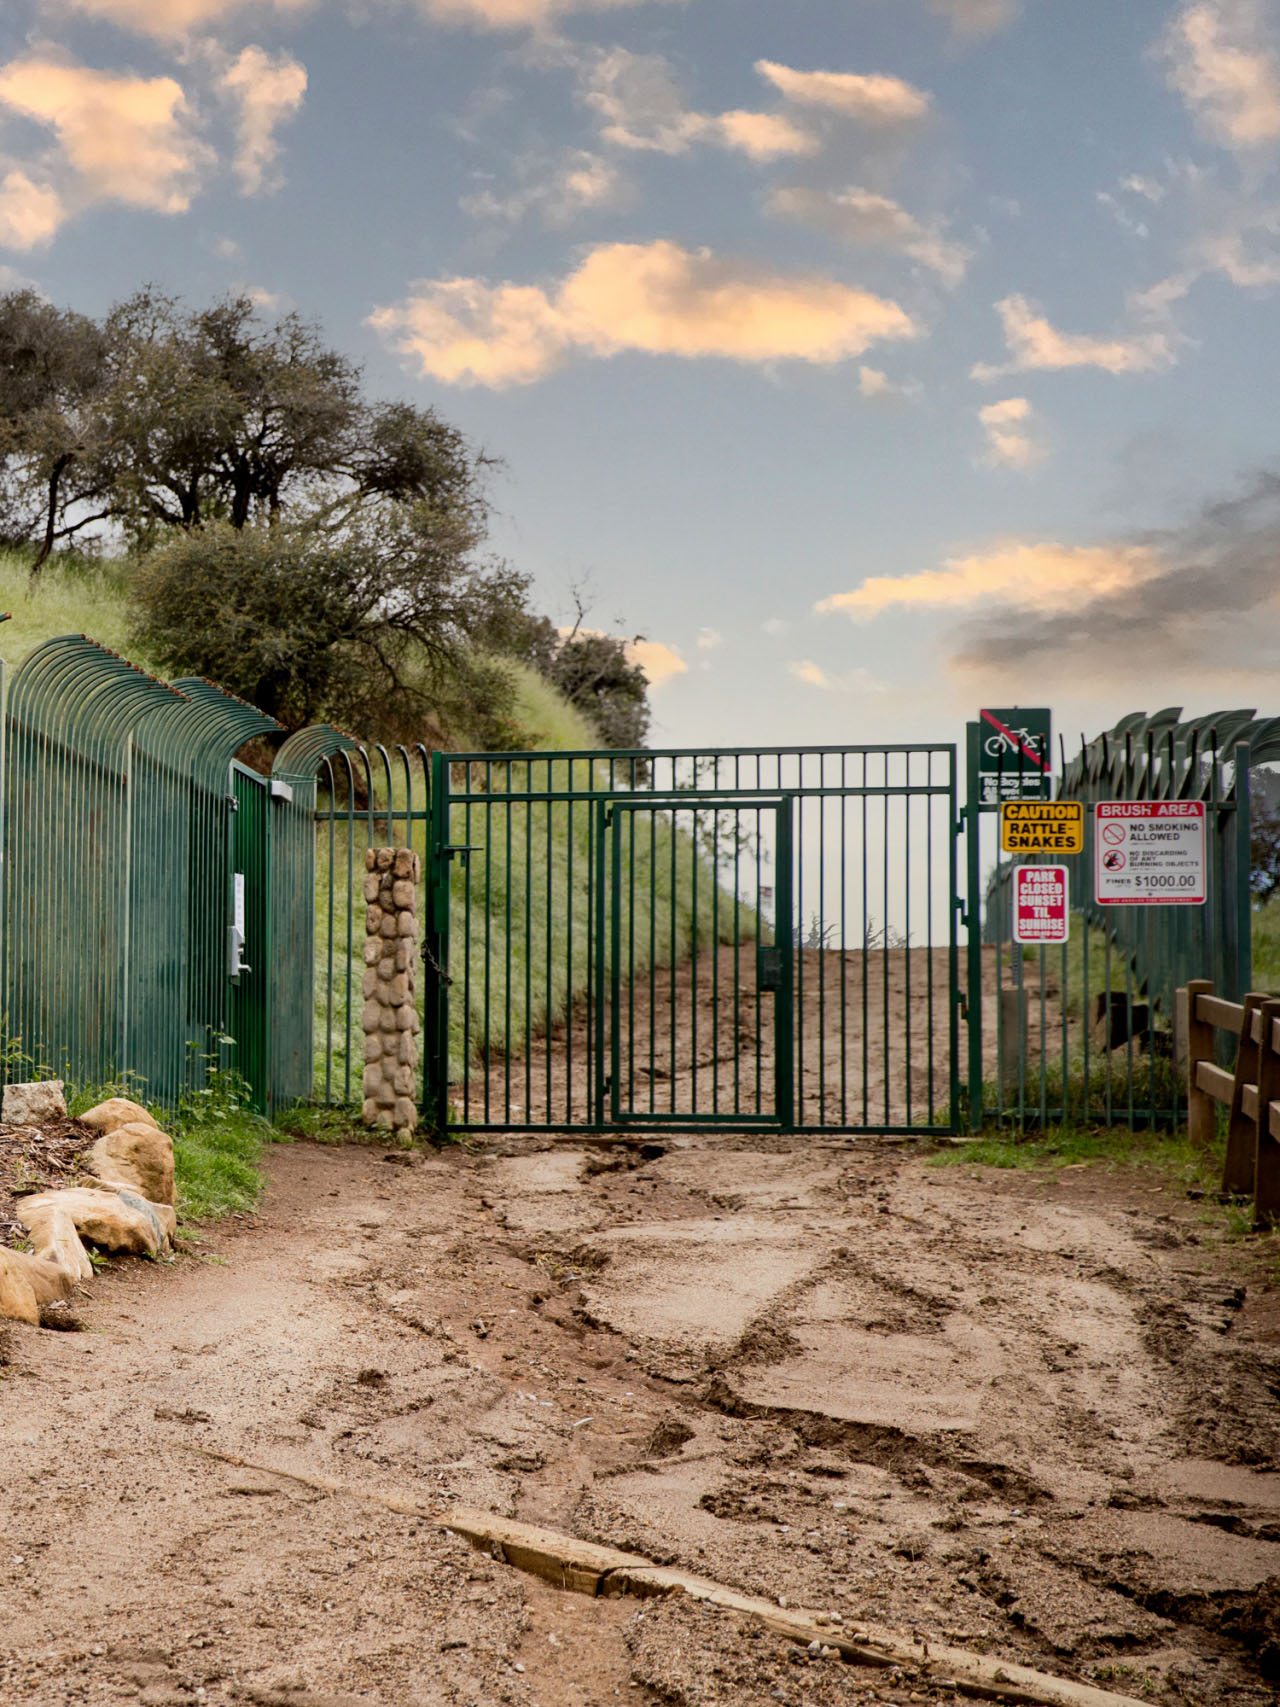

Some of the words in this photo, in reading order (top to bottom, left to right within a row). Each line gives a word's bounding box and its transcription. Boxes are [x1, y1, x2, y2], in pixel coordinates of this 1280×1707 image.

[984, 777, 999, 787] No
[1006, 805, 1079, 820] CAUTION
[1101, 805, 1152, 817] BRUSH
[1158, 804, 1199, 816] AREA
[1010, 823, 1074, 835] RATTLE-
[1130, 823, 1145, 832] NO
[1148, 823, 1199, 832] SMOKING
[1008, 836, 1076, 848] SNAKES
[1130, 832, 1181, 841] ALLOWED
[1026, 871, 1057, 883] PARK
[1135, 875, 1196, 887] $1000.00
[1020, 883, 1063, 895] CLOSED
[1019, 895, 1064, 907] SUNSET
[1032, 907, 1051, 918] TIL
[1019, 918, 1065, 930] SUNRISE
